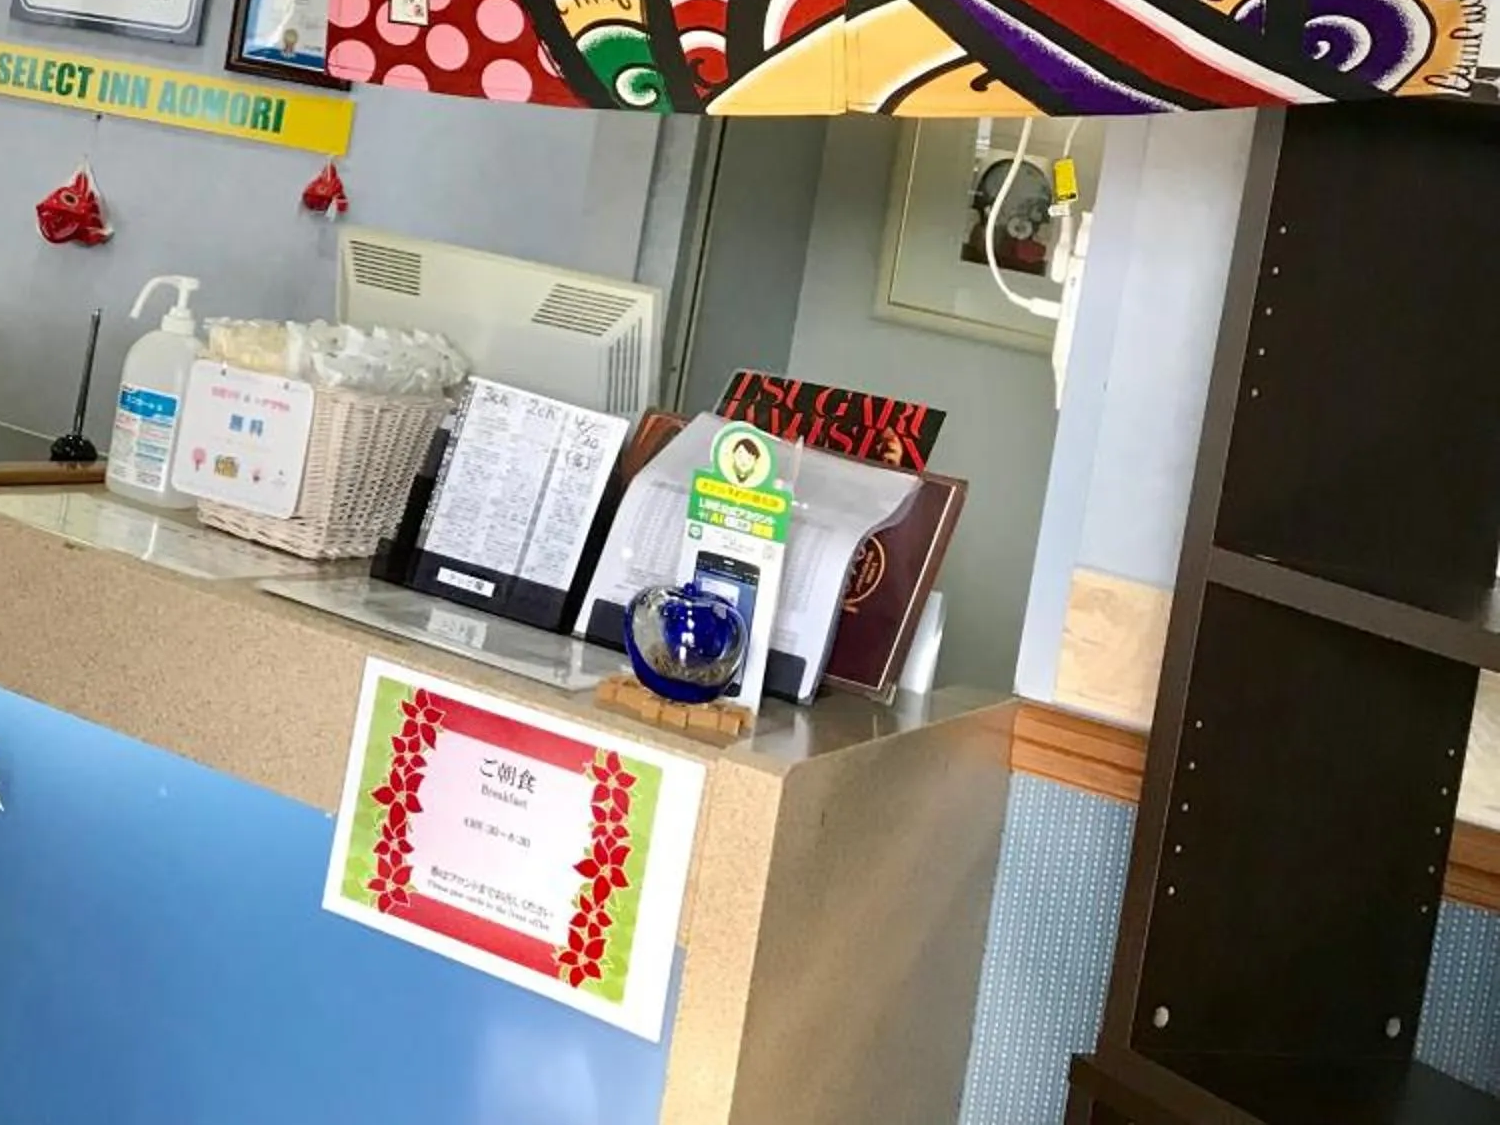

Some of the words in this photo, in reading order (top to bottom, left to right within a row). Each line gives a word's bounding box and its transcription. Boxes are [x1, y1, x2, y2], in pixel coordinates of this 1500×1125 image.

[98, 69, 152, 111] INN
[155, 78, 287, 135] AOMORI
[479, 757, 536, 794] ご朝食
[481, 783, 529, 810] Breakfast
